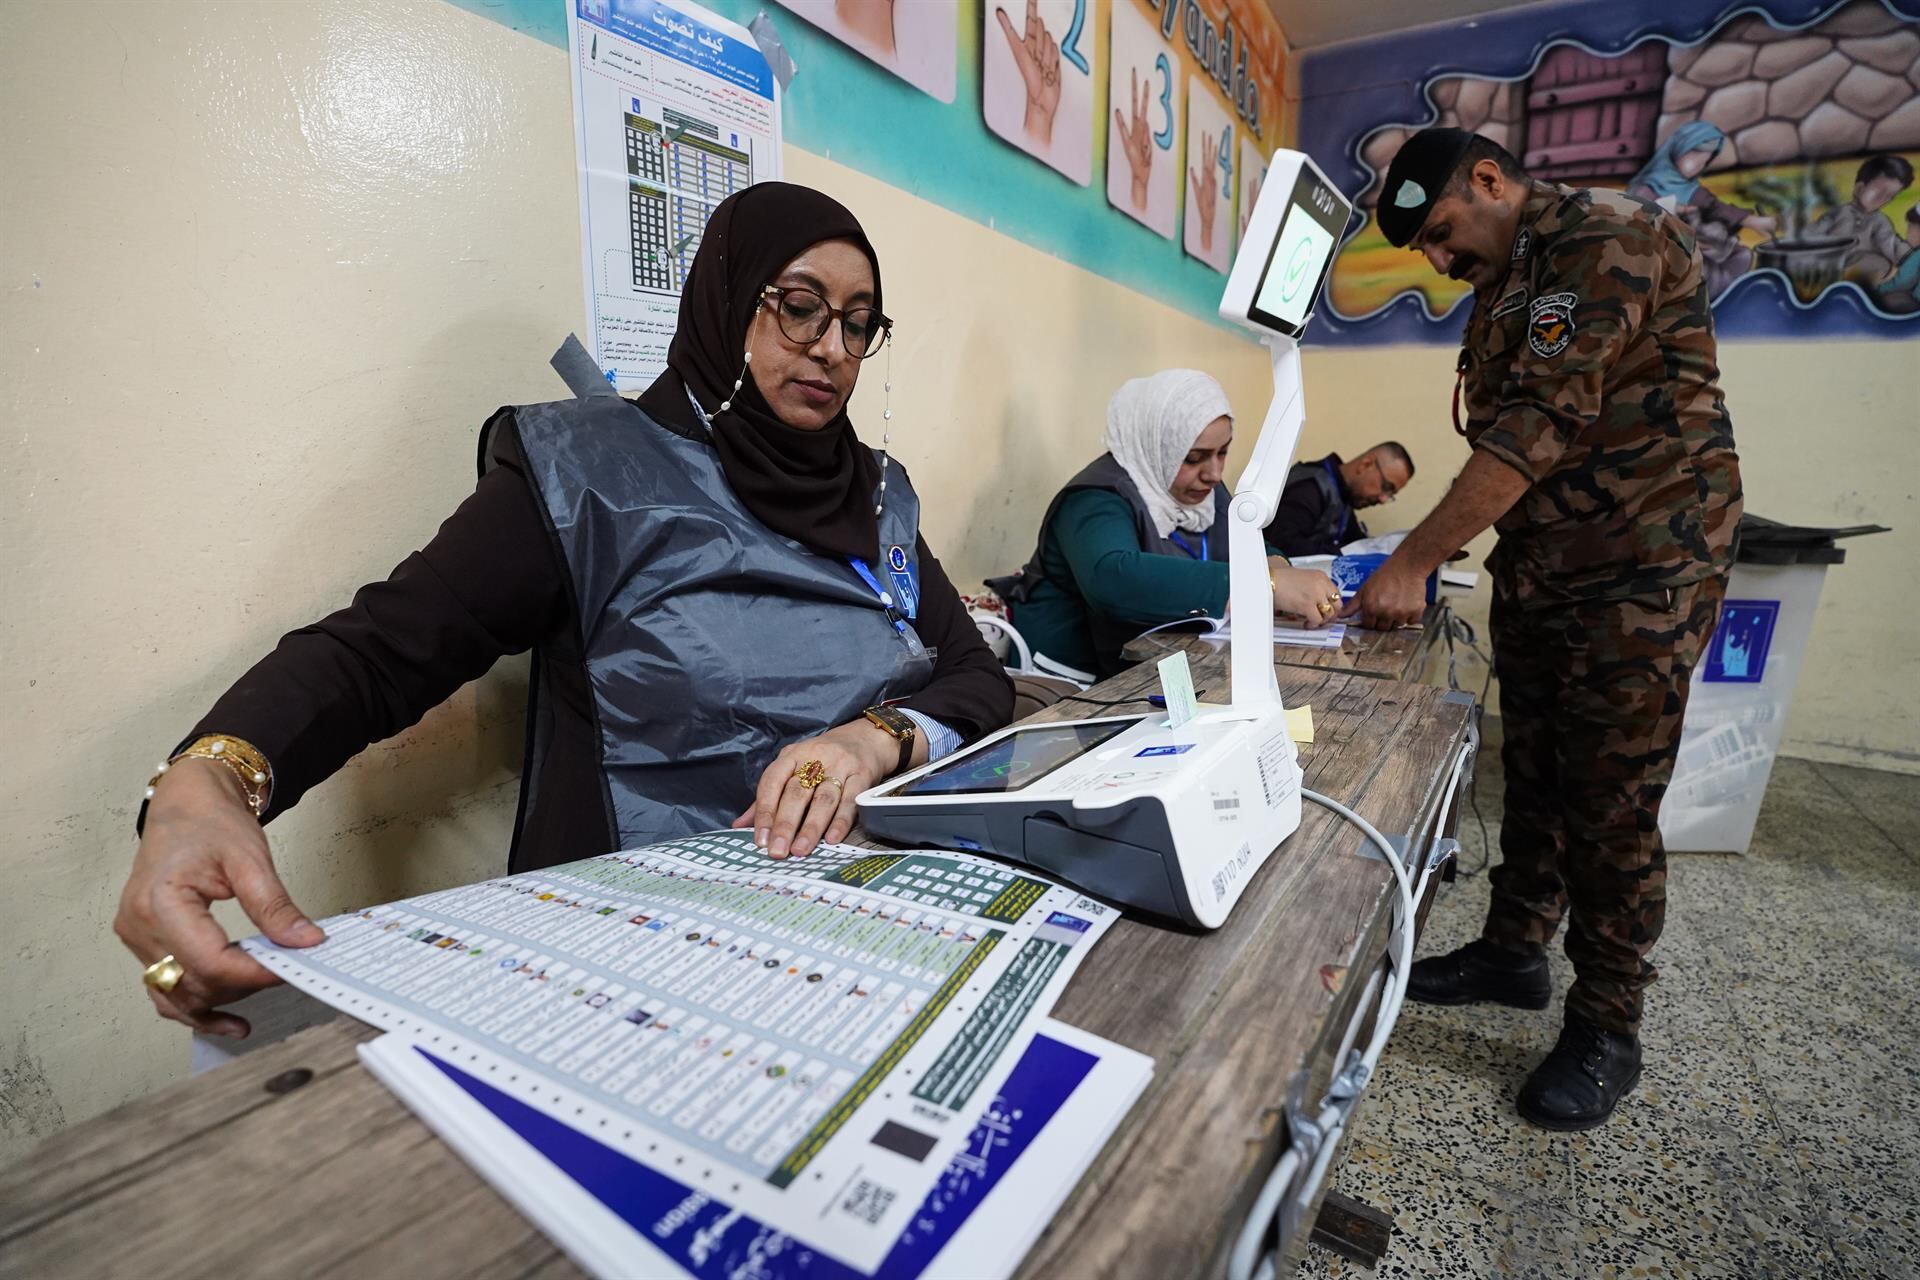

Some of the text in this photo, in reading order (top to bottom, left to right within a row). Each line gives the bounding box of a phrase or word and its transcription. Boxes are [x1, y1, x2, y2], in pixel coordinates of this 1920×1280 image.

[653, 9, 723, 54] كيف تصوت
[1154, 52, 1174, 151] 3
[1218, 124, 1233, 199] 4
